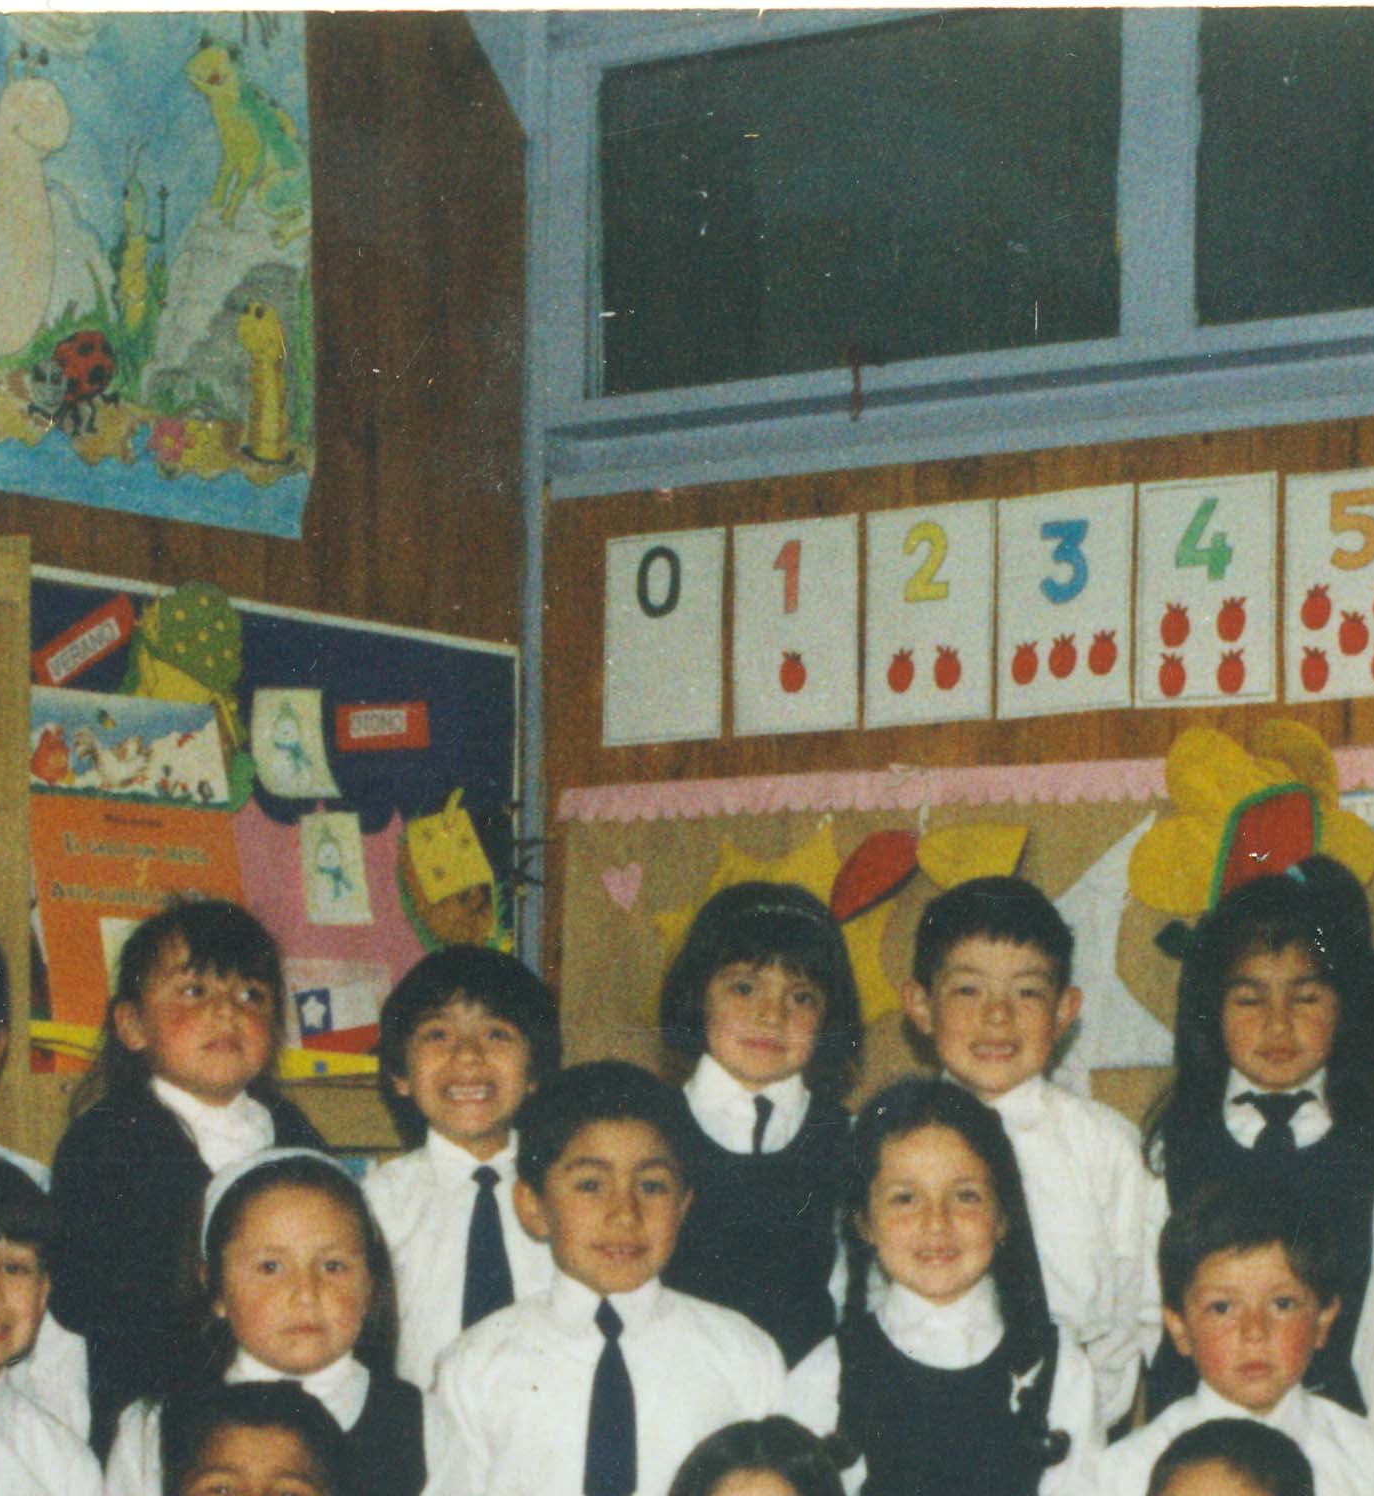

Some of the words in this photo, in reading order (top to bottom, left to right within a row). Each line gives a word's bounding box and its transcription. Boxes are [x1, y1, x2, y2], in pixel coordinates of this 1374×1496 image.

[636, 545, 682, 618] 0
[772, 539, 802, 614] 1
[902, 520, 949, 602] 2
[1039, 518, 1089, 604] 3
[1174, 497, 1232, 581] 4
